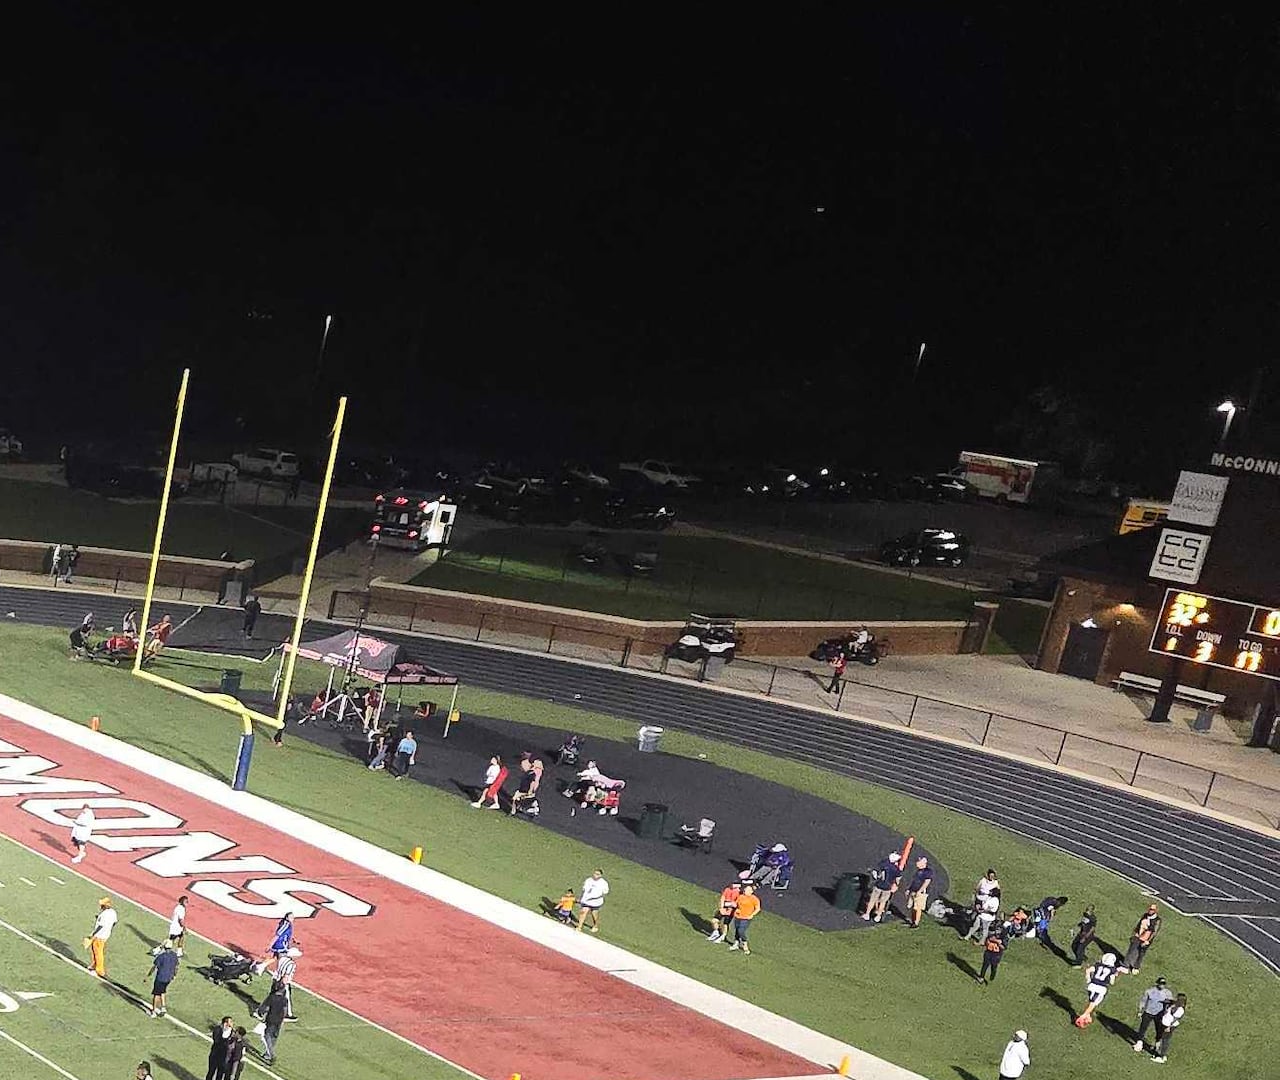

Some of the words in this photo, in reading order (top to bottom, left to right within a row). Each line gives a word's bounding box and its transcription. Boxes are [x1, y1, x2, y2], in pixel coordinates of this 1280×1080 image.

[1196, 630, 1223, 645] DOWN
[1238, 638, 1249, 651] TO
[1250, 642, 1263, 654] GO
